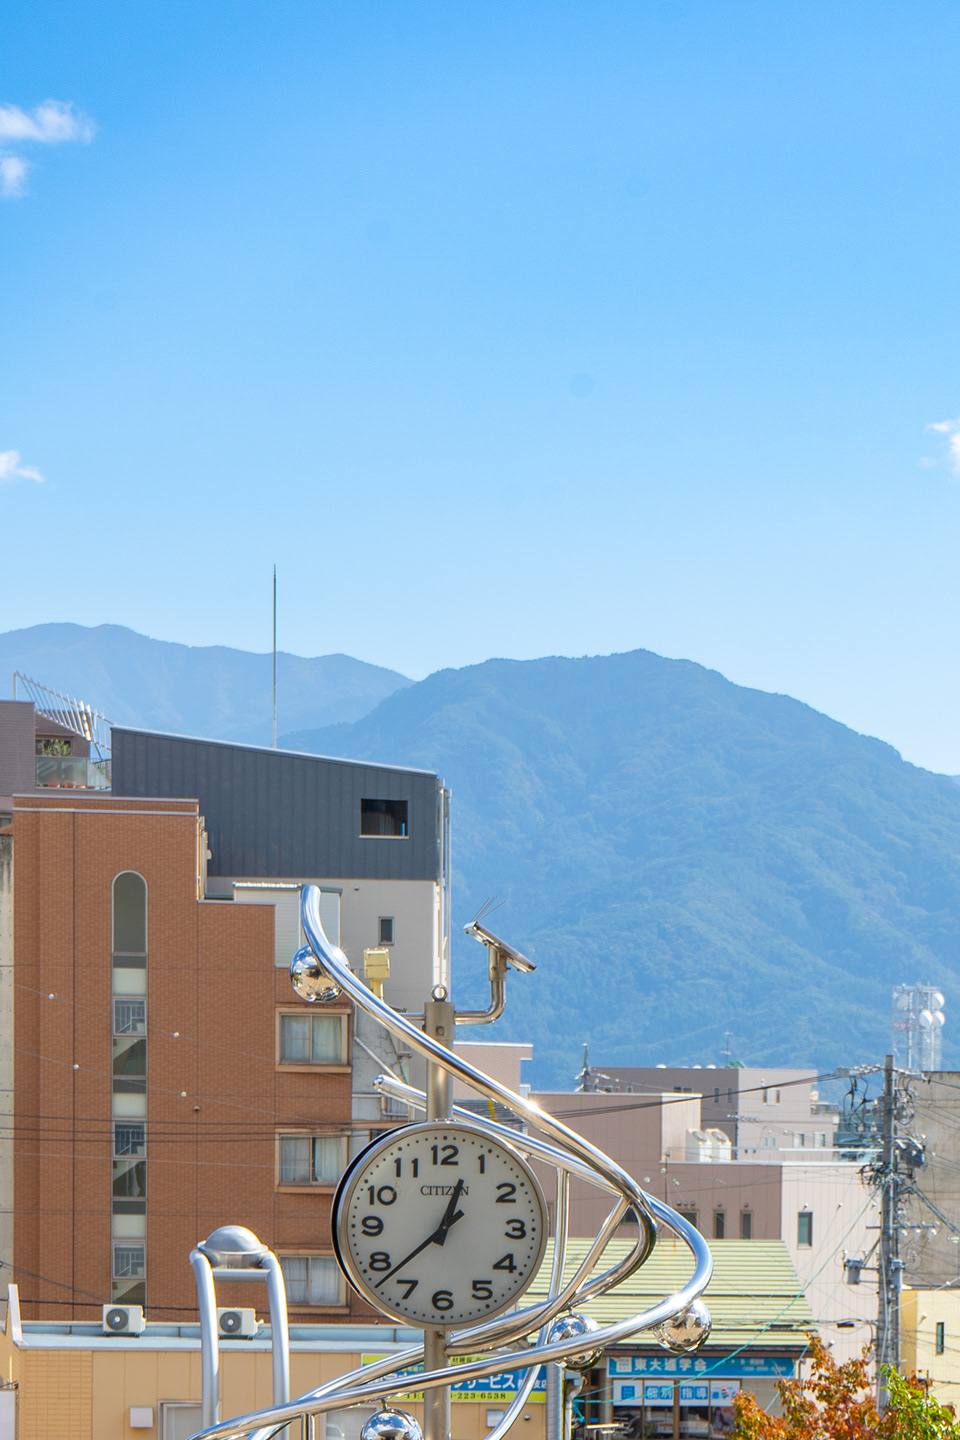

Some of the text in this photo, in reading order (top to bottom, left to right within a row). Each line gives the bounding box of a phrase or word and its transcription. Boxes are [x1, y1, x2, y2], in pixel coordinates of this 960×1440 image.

[431, 1145, 459, 1165] 12
[478, 1154, 485, 1174] 1
[394, 1158, 418, 1178] 11
[367, 1185, 397, 1205] 10
[495, 1182, 517, 1203] 2
[362, 1216, 384, 1237] 9
[504, 1219, 526, 1240] 3
[369, 1252, 392, 1272] 8
[493, 1253, 517, 1274] 4
[396, 1279, 419, 1300] 7
[471, 1280, 493, 1300] 5
[431, 1290, 454, 1311] 6
